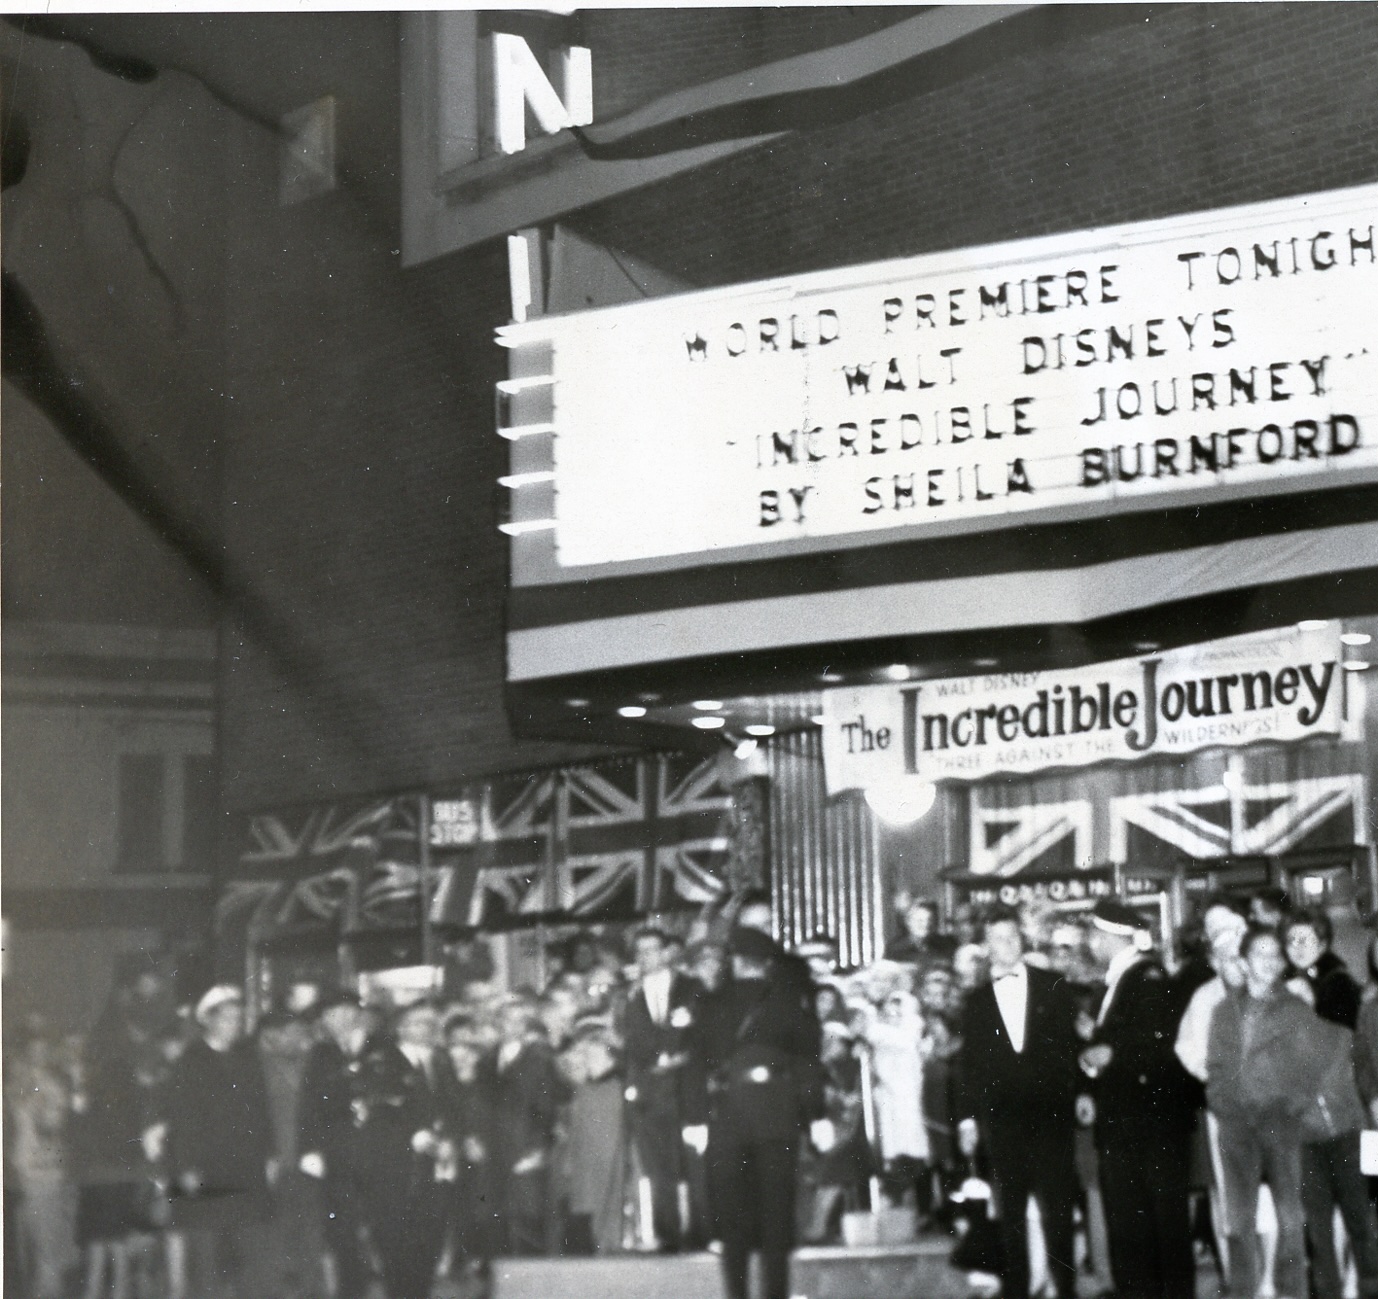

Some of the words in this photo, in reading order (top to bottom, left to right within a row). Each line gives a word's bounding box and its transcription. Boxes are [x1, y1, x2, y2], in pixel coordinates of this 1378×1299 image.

[494, 31, 593, 155] N
[683, 308, 840, 362] WORLD
[883, 263, 1121, 334] PREMIERE
[841, 347, 964, 396] WALT
[1020, 308, 1237, 375] DISNEYS
[758, 485, 815, 528] BY
[861, 456, 1035, 514] SHEILA
[1078, 413, 1361, 488] BURNFORD
[841, 713, 892, 754] The
[899, 682, 1138, 775] Incredible
[1124, 657, 1338, 752] Journey
[935, 678, 977, 698] WALT
[983, 671, 1042, 692] DISNEY
[995, 741, 1074, 765] AGAINST
[430, 822, 478, 846] STOP
[433, 800, 473, 822] BUS
